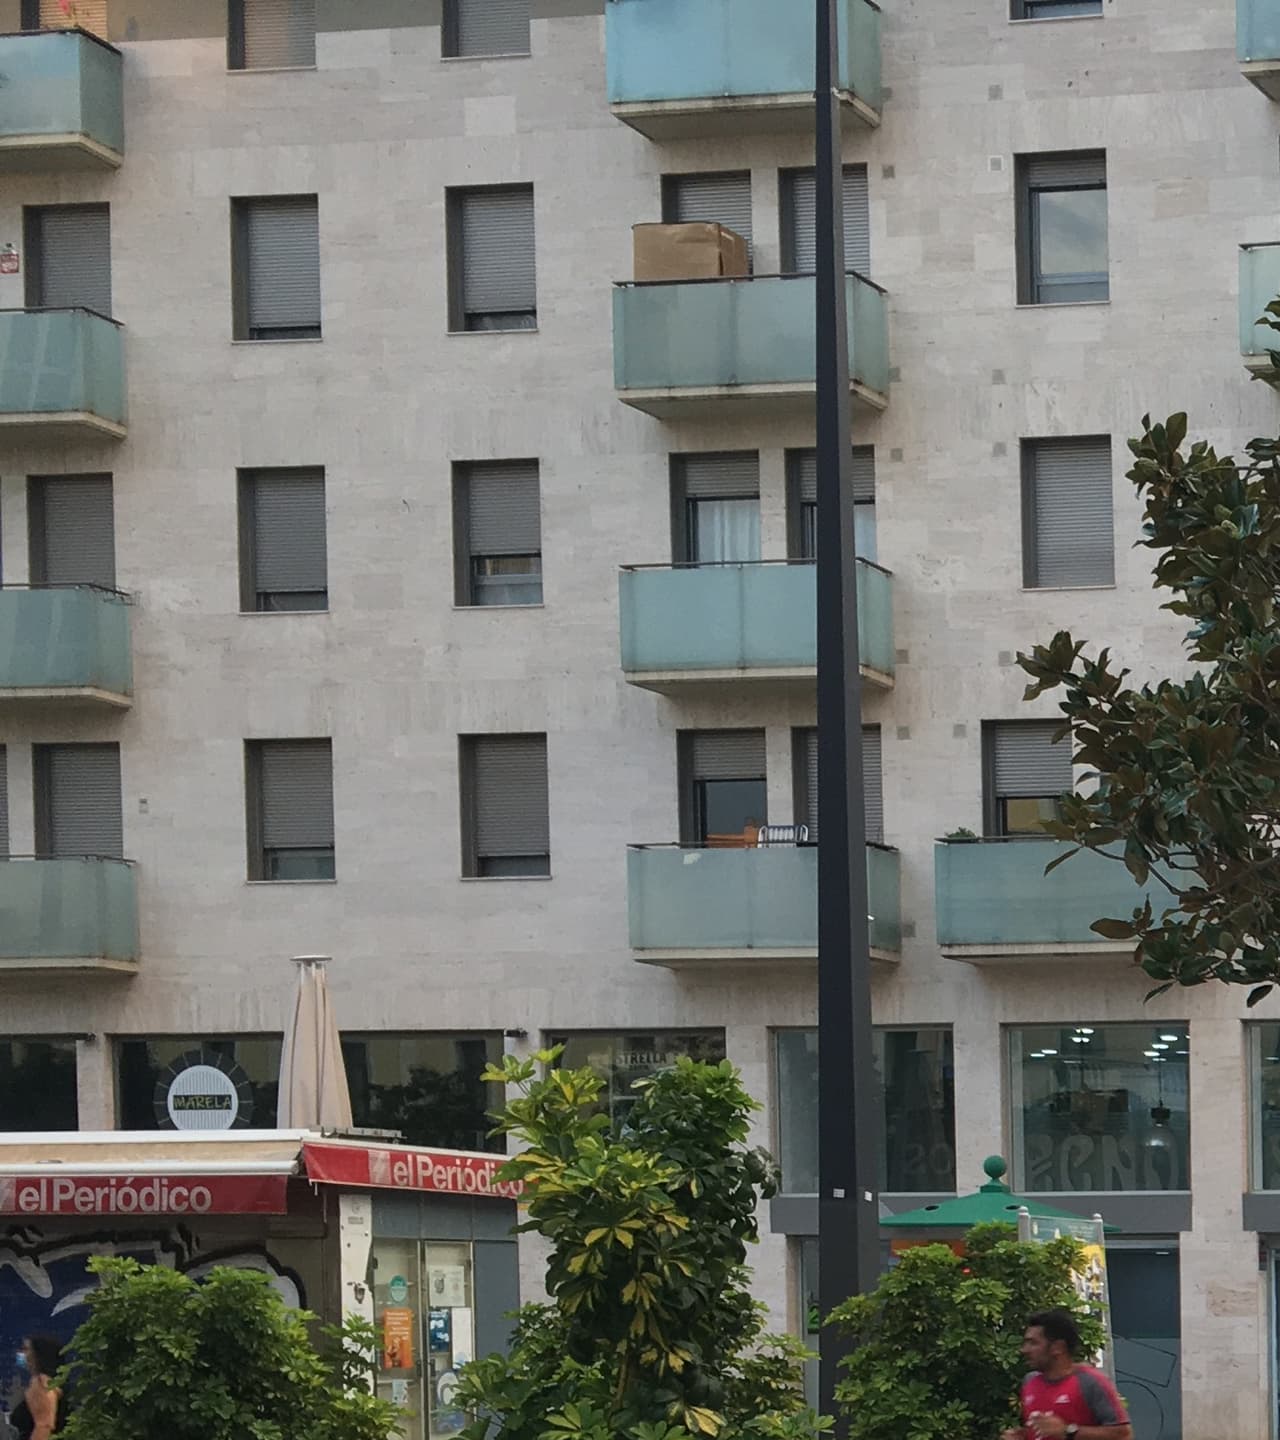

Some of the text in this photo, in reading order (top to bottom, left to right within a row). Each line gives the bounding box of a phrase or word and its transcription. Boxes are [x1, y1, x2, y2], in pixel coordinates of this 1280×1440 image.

[616, 1051, 667, 1065] STRELLA
[174, 1095, 231, 1109] MARELA
[393, 1154, 413, 1186] el
[19, 1177, 212, 1213] el Periódico
